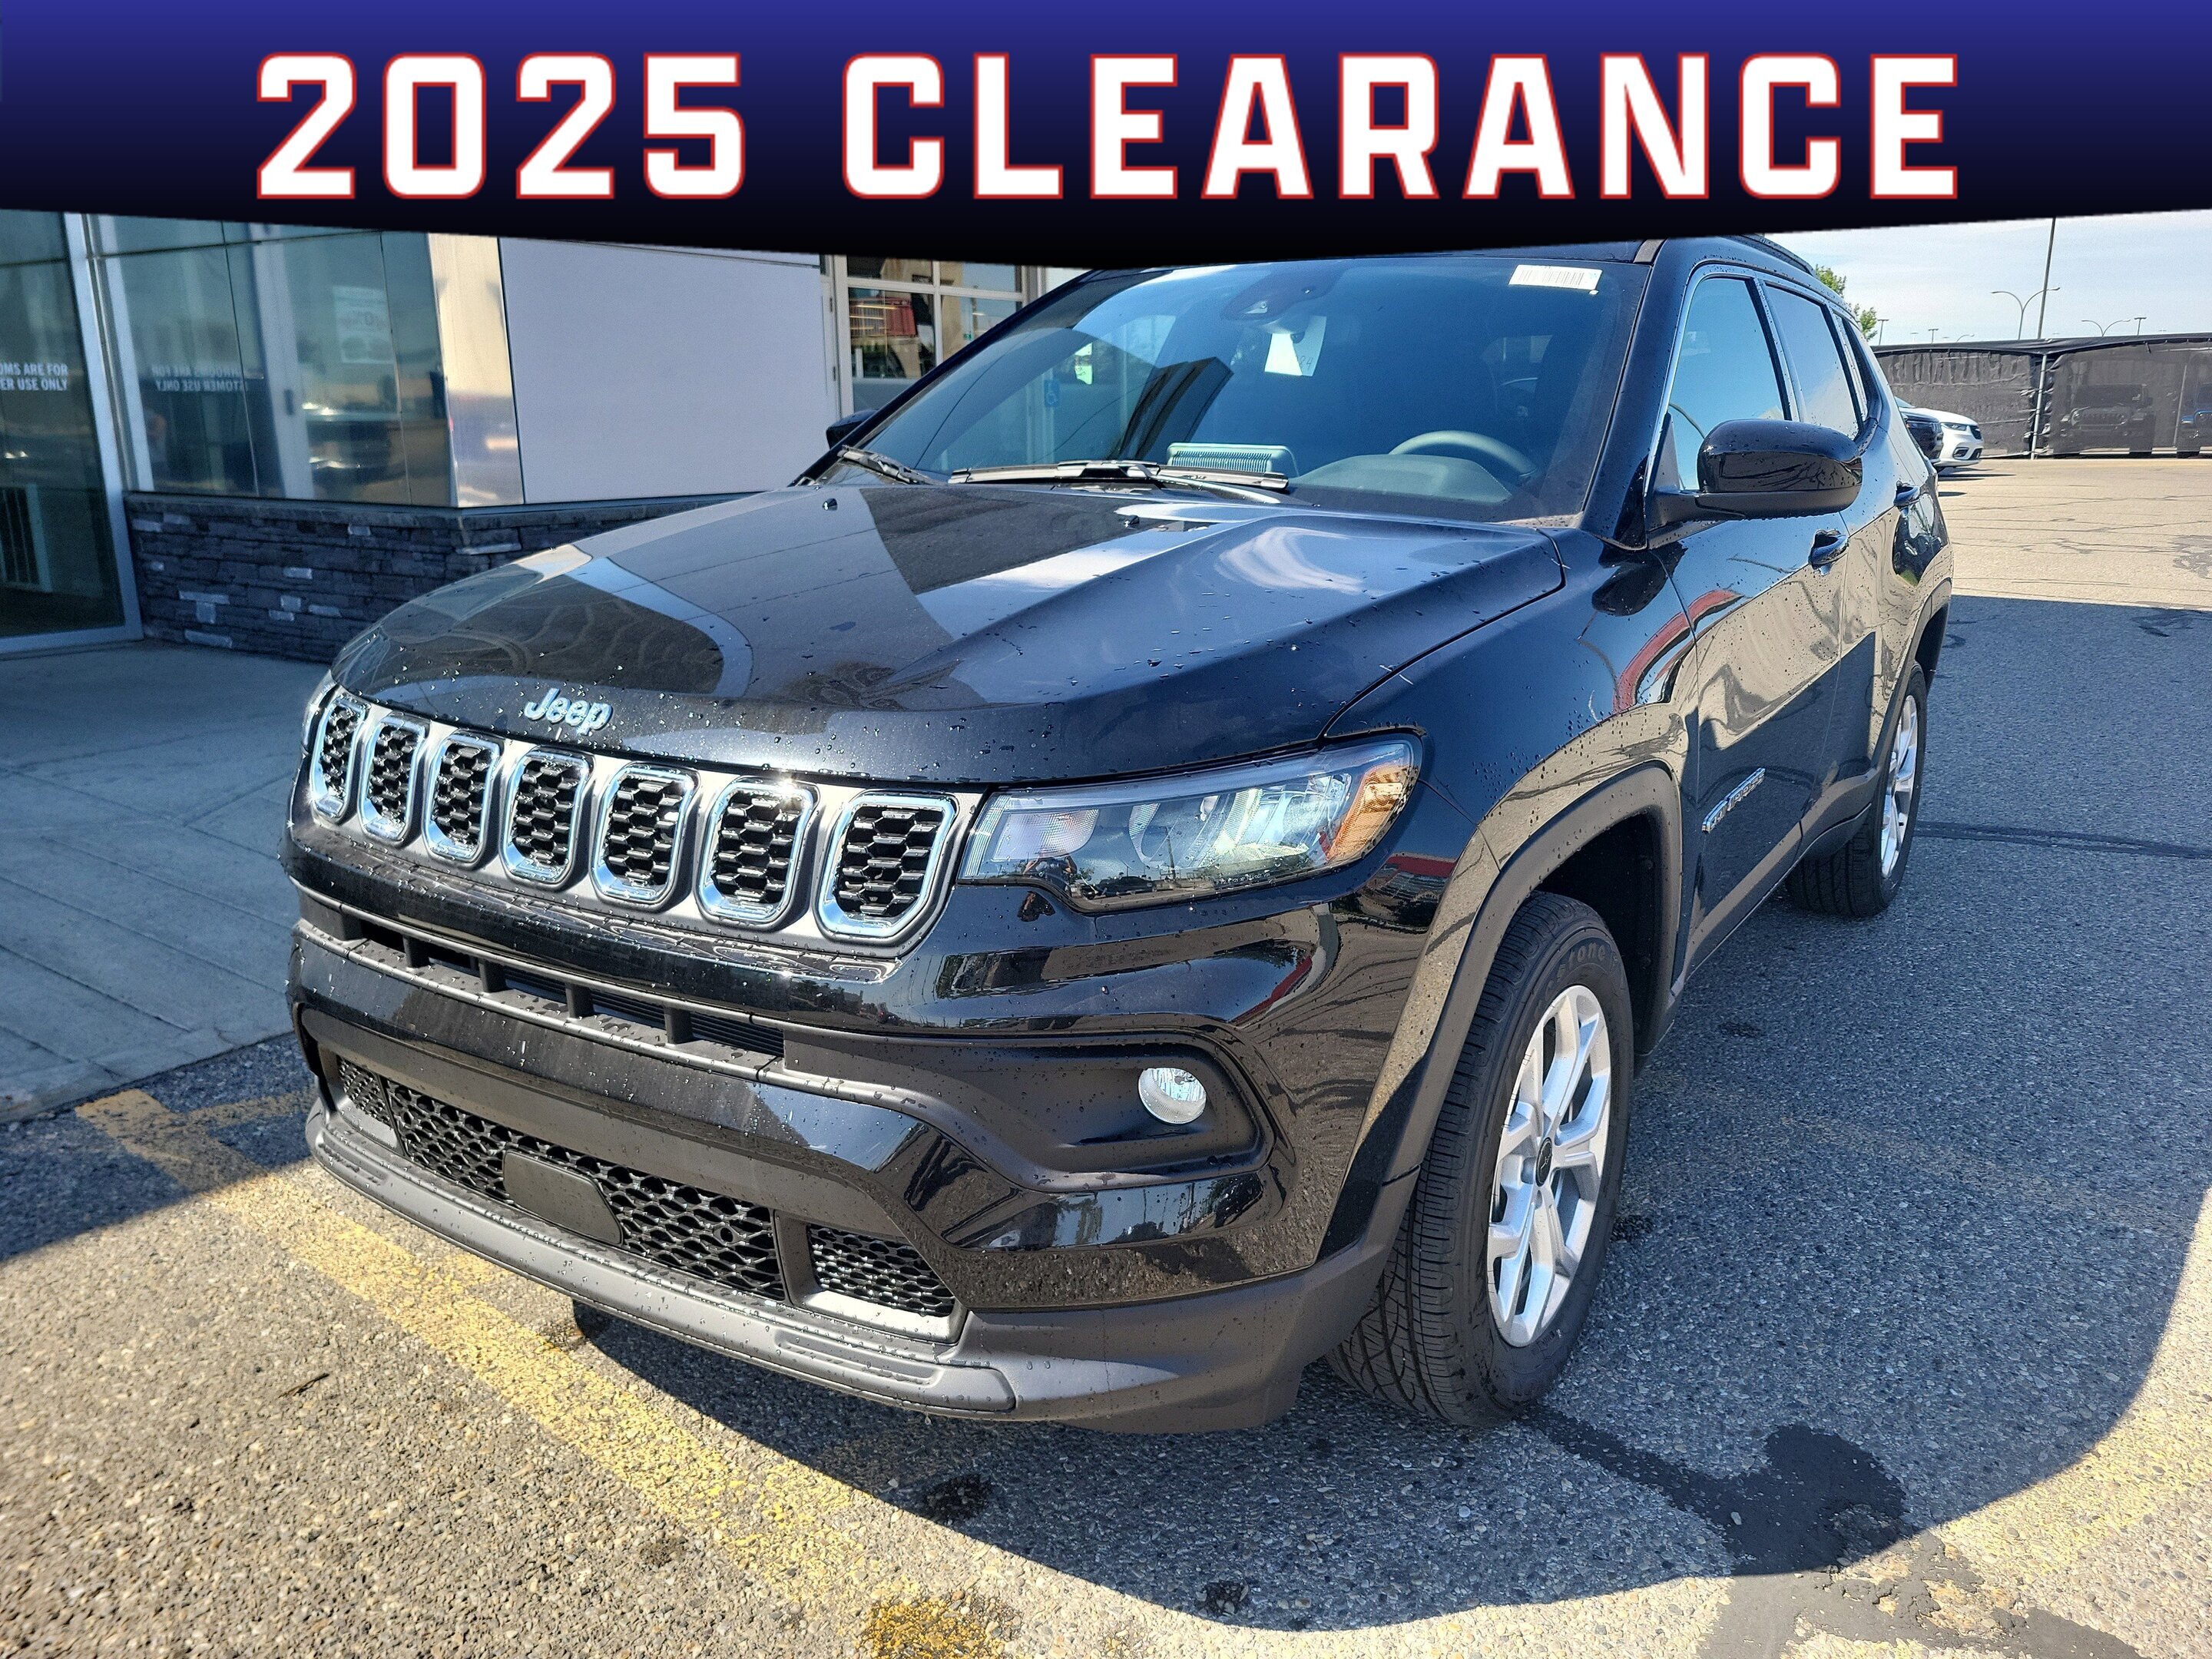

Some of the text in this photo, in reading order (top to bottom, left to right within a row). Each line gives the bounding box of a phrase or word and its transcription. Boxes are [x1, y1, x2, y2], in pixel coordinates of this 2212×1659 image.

[24, 362, 44, 376] ARE
[47, 362, 68, 376] FOR
[18, 377, 38, 391] USE
[41, 377, 68, 391] ONLY
[524, 687, 614, 736] Jeep
